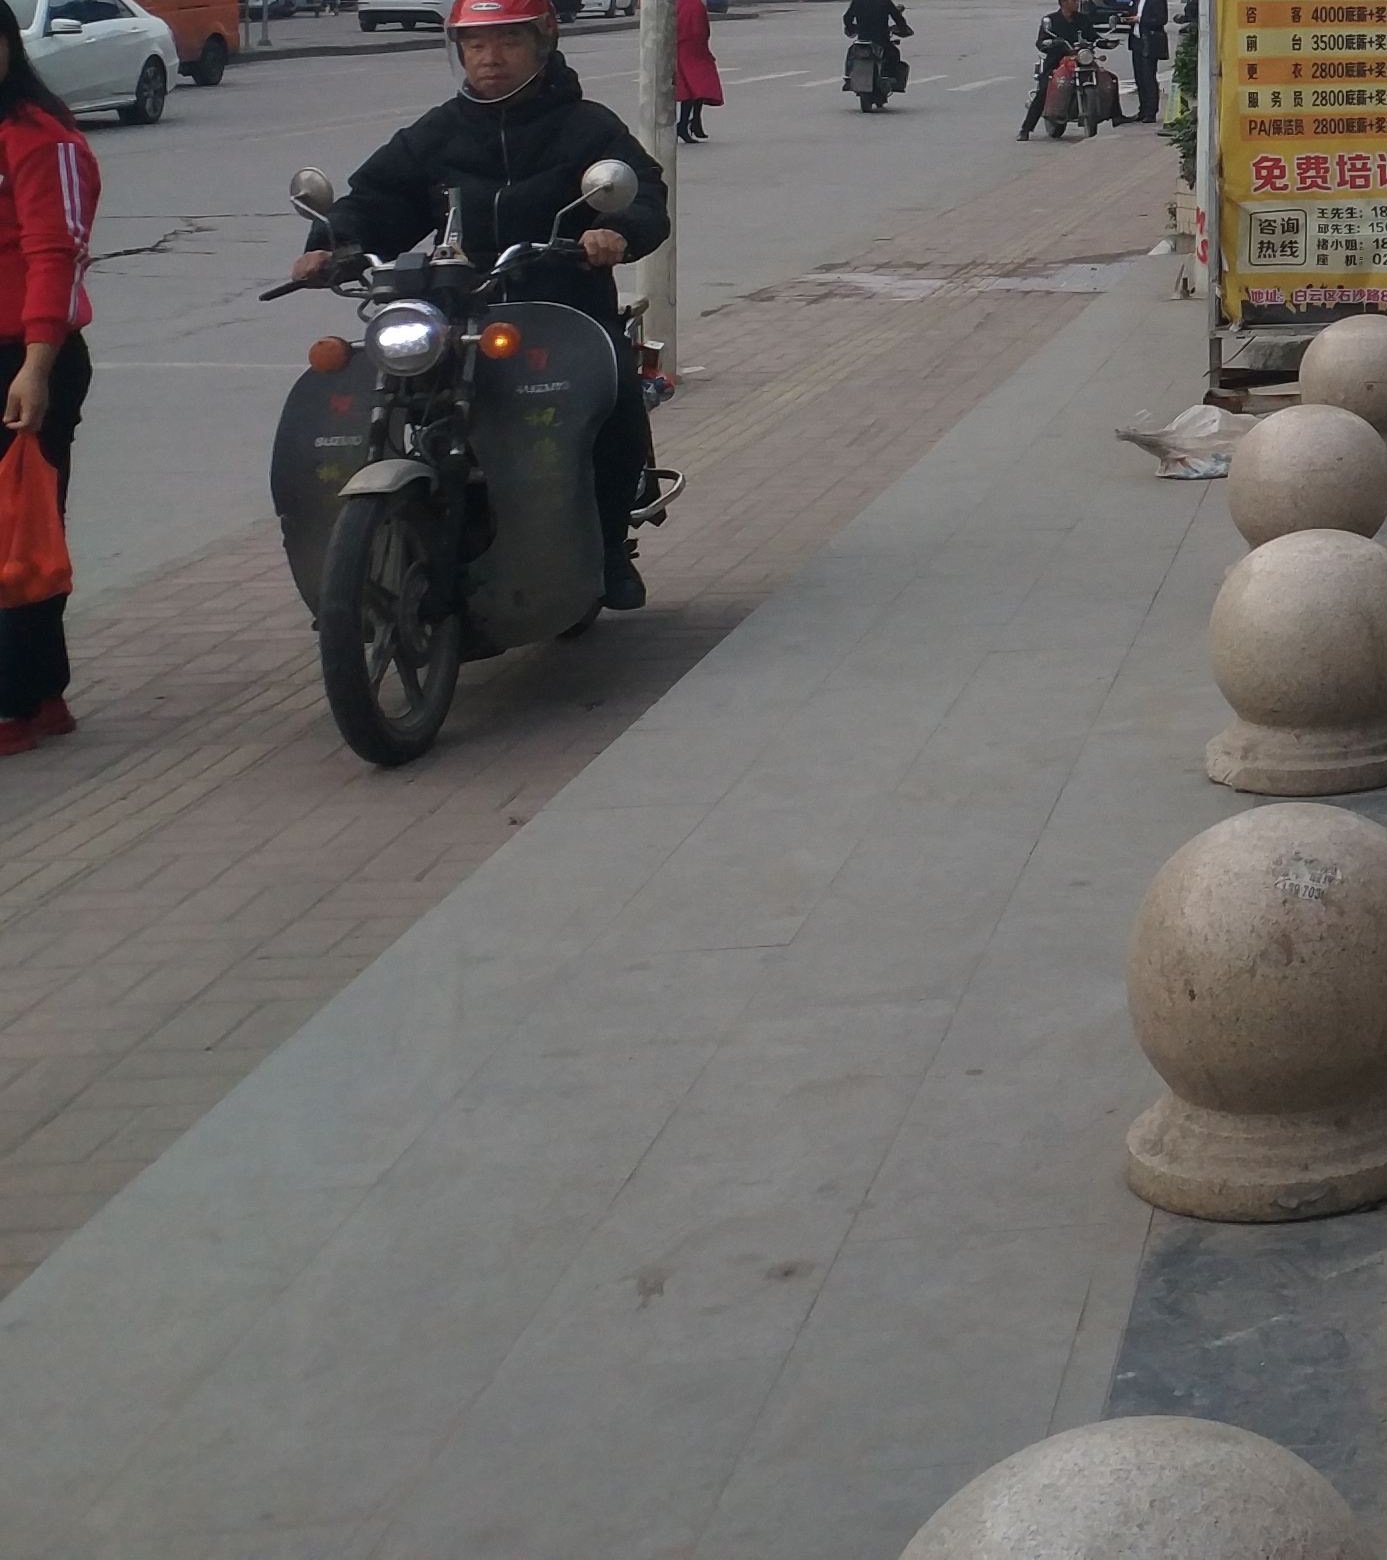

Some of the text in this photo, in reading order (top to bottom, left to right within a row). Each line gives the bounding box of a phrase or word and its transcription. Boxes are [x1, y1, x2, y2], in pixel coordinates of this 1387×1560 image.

[1247, 91, 1304, 109] 服务员
[1257, 217, 1300, 235] 咨询
[1257, 240, 1300, 259] 热线
